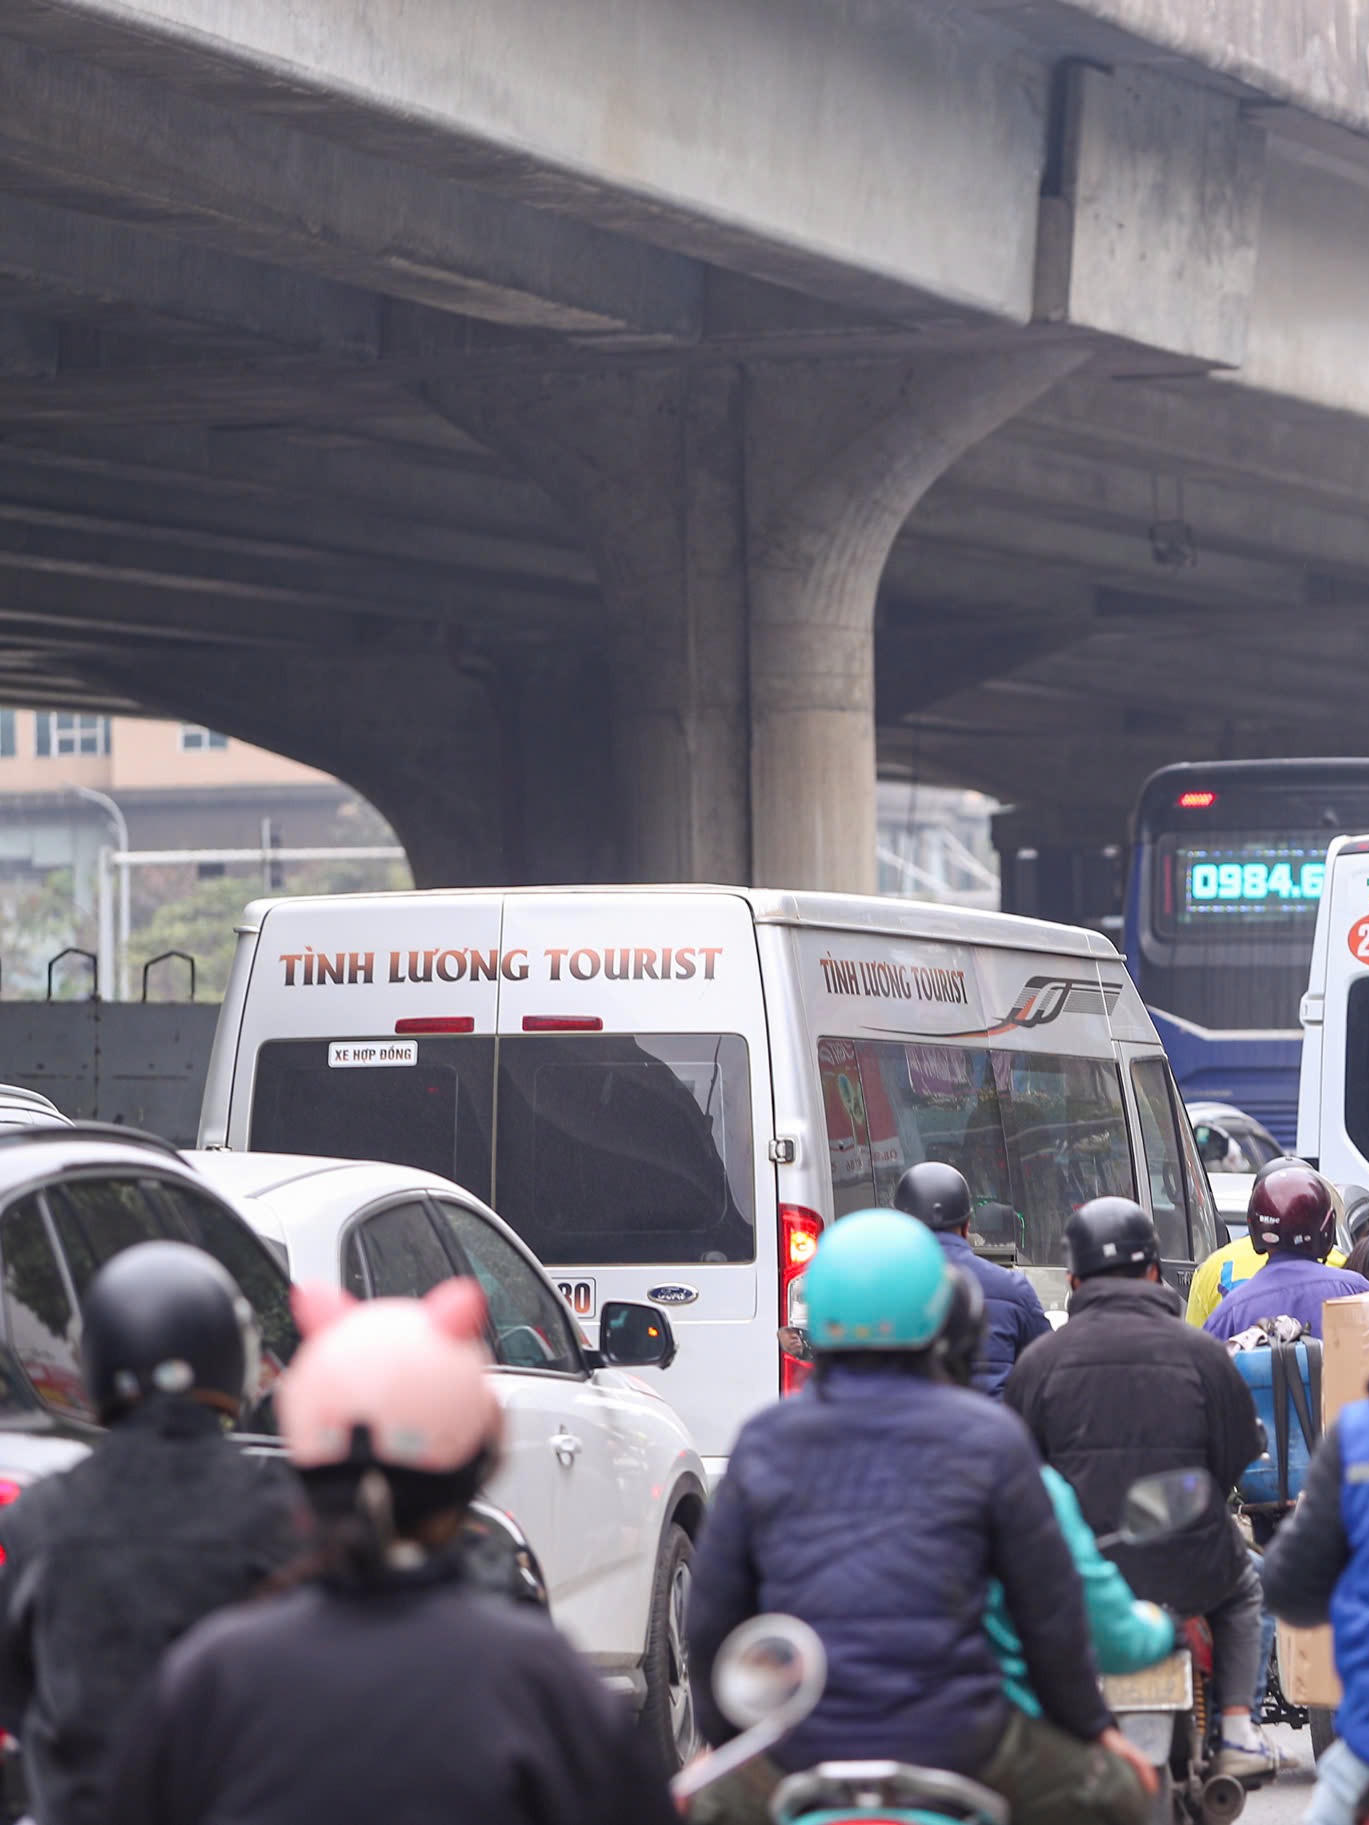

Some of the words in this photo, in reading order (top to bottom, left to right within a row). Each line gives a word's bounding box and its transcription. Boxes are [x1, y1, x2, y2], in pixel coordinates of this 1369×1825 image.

[1193, 862, 1326, 899] 0984.6
[279, 945, 374, 987] TÌNH
[388, 946, 530, 983] LƯƠNG
[544, 947, 724, 983] TOURIST
[820, 951, 861, 996] TÌNH
[859, 960, 912, 999] LƯƠNG
[910, 966, 969, 1005] TOURIST
[335, 1049, 349, 1062] XE
[353, 1047, 376, 1064] HỢP
